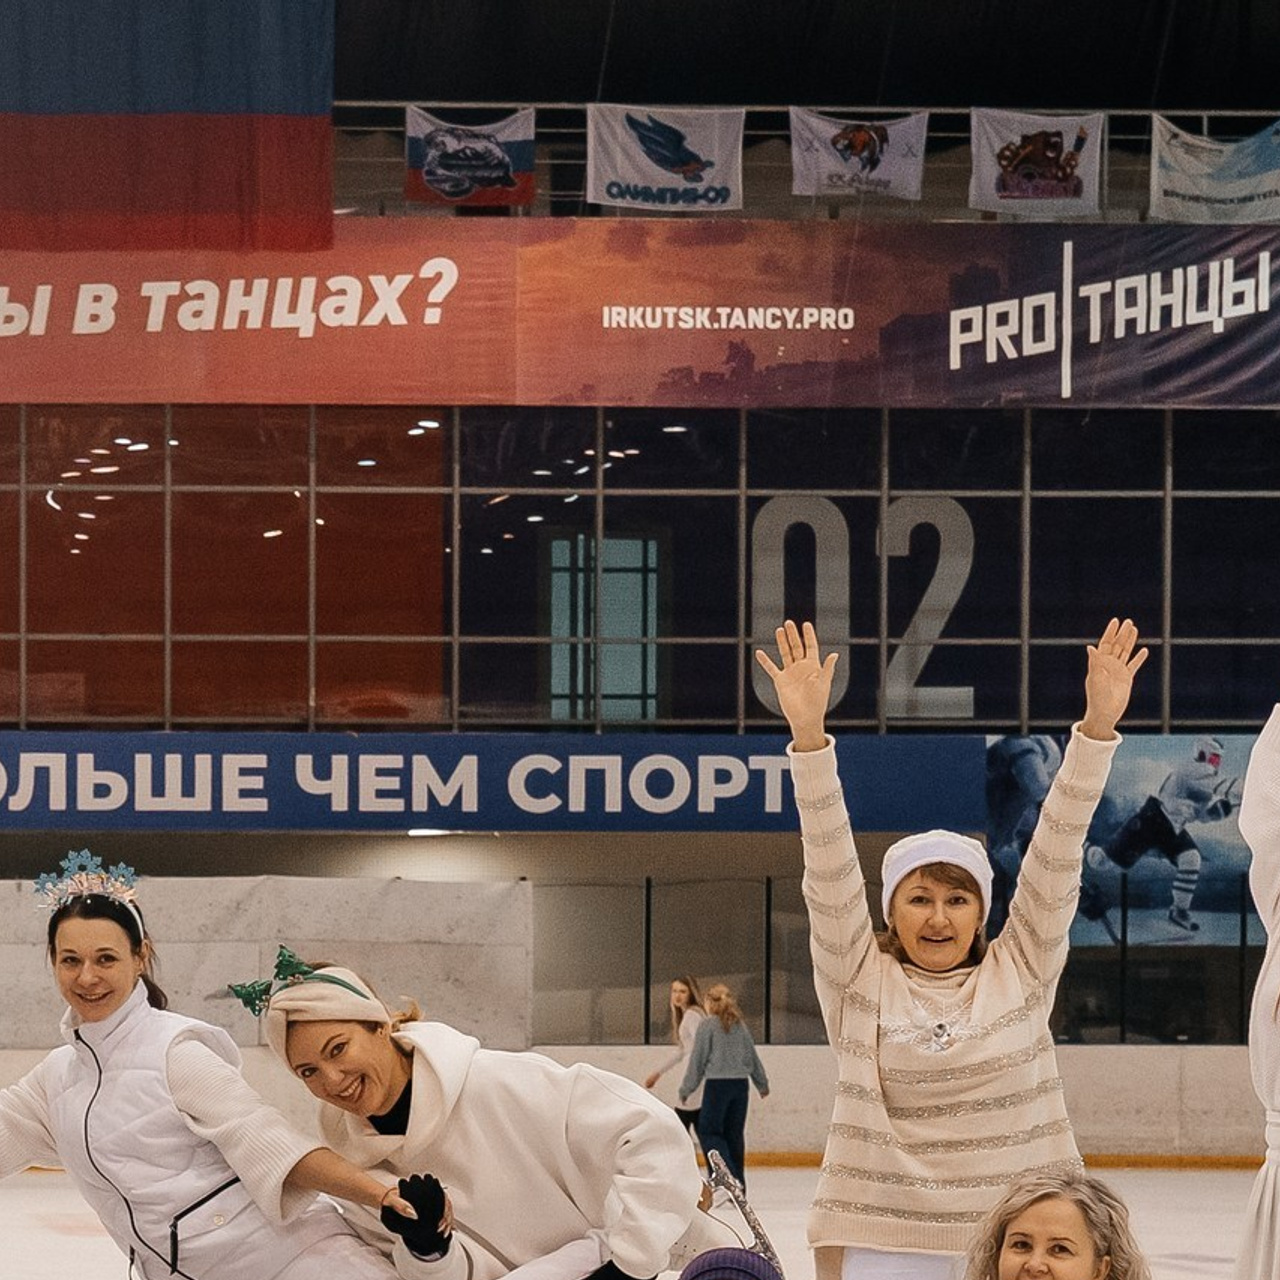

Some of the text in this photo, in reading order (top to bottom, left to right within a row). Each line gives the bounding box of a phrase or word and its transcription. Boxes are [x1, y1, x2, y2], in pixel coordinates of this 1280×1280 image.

[72, 282, 119, 336] в
[140, 256, 459, 338] танцах?
[601, 305, 856, 331] IRKUTSK.TANCY.PRO
[751, 495, 975, 719] 02
[295, 754, 479, 813] ЧЕМ
[507, 753, 791, 814] СПОРТ
